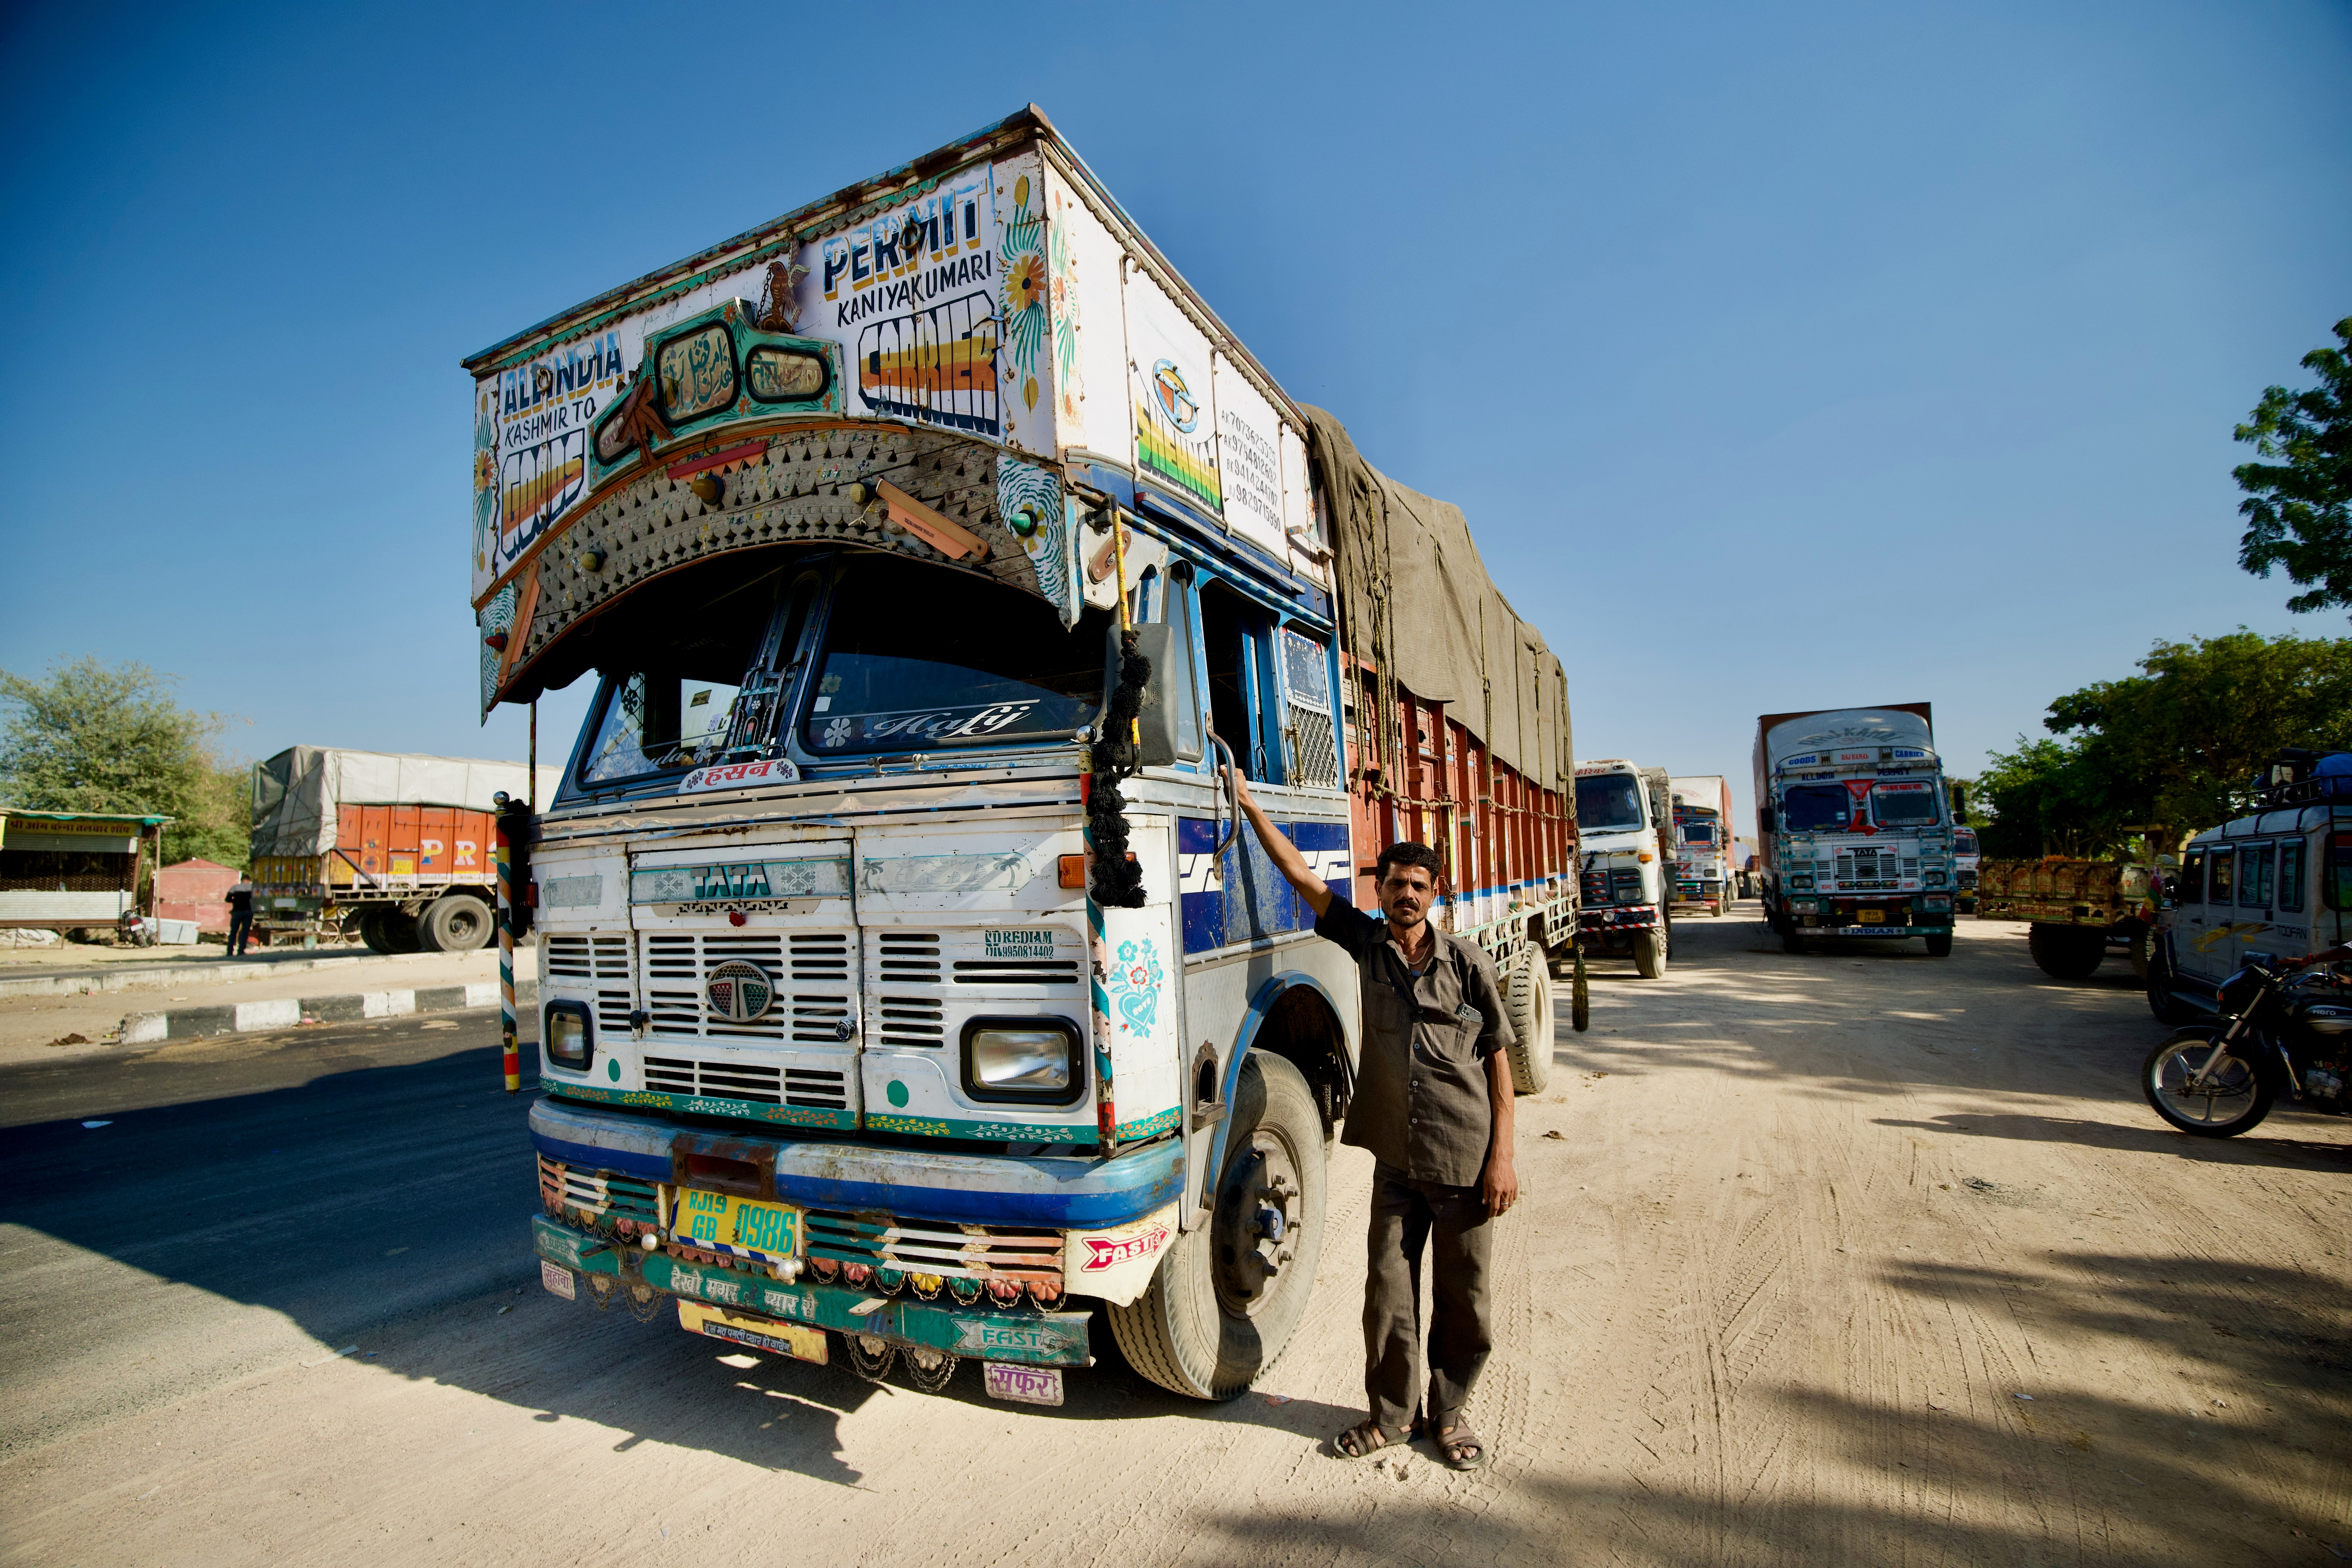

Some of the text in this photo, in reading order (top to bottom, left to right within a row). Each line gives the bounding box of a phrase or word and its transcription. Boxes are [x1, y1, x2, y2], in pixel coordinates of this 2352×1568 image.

[823, 178, 988, 301] PERMIT
[837, 250, 991, 328] KANIYAKUMARI
[858, 290, 1000, 436] CARRIER
[505, 406, 568, 447] KASHMIR
[572, 397, 595, 422] TO
[501, 427, 585, 561] GOODS
[1789, 756, 1816, 765] GOODS
[1877, 768, 1911, 776] PERMIT
[705, 761, 776, 786] हसन
[691, 865, 771, 897] TATA
[2277, 925, 2307, 940] TOOFAN
[689, 1191, 728, 1214] RJ19
[691, 1216, 717, 1241] GB
[549, 1237, 569, 1254] SUPER
[1099, 1237, 1151, 1262] FAST
[545, 1269, 570, 1289] सुहाना
[670, 1265, 704, 1294] देखो
[706, 1277, 740, 1302] मगर
[802, 1291, 818, 1320] से
[762, 1335, 770, 1347] हो
[982, 1329, 1040, 1347] FAST
[993, 1367, 1052, 1398] सफर
